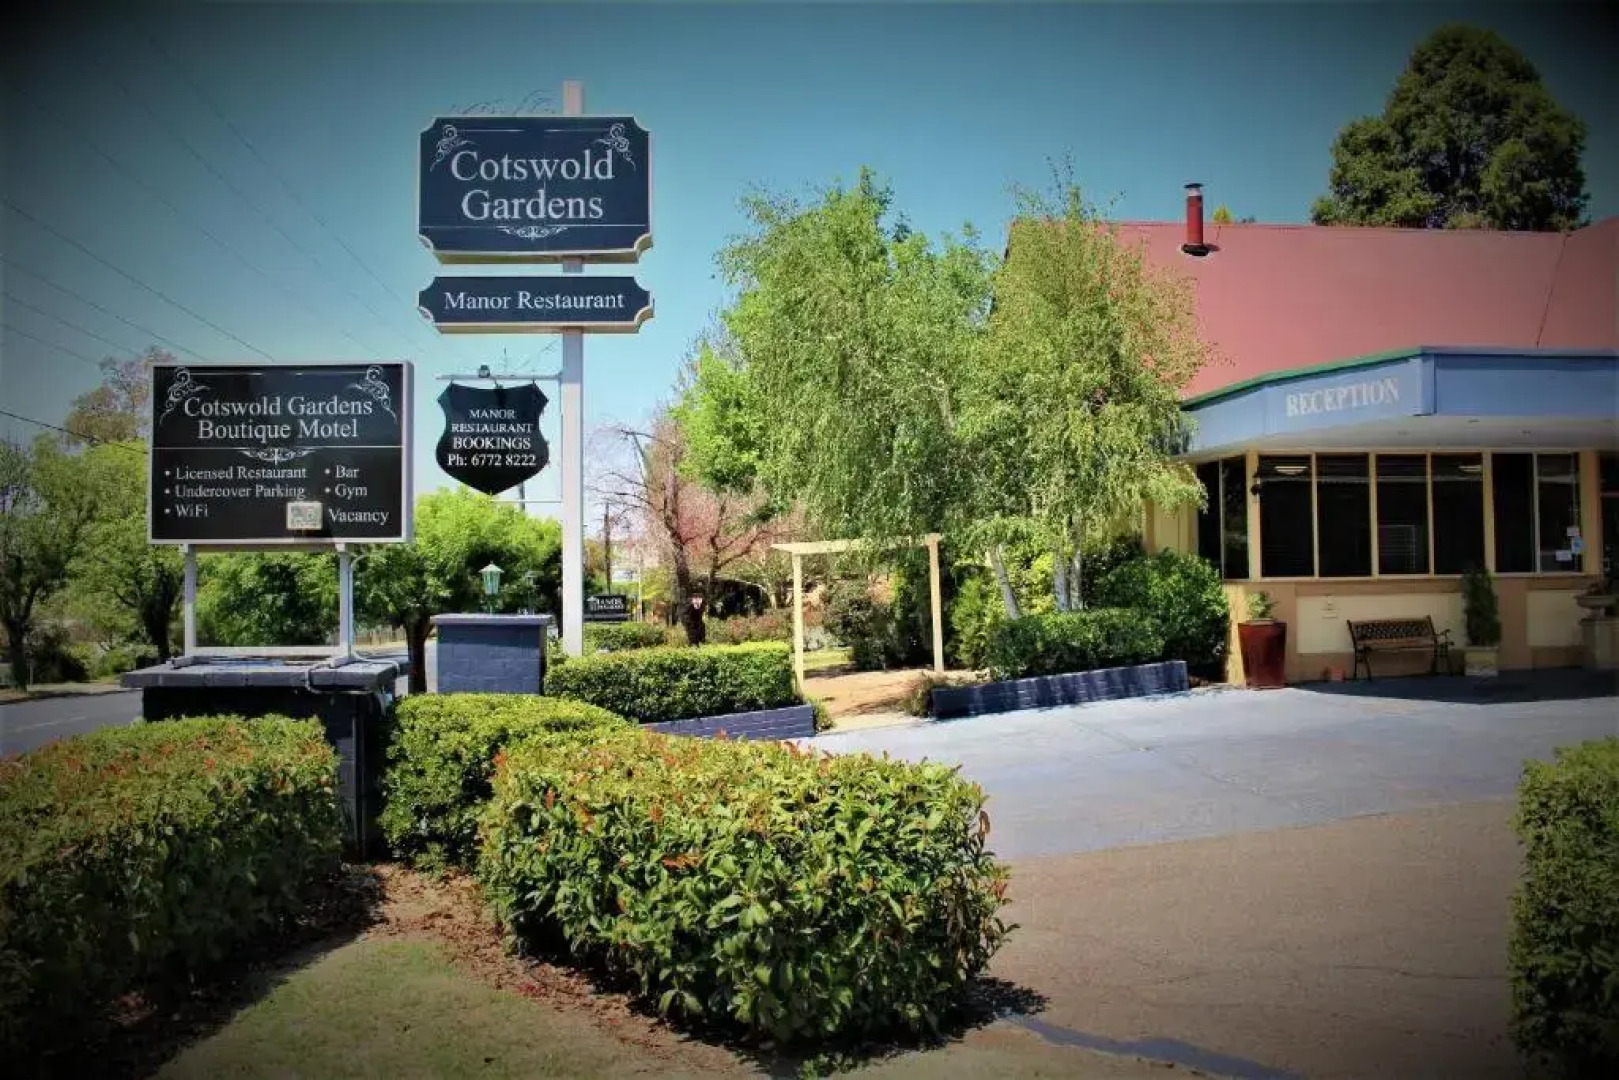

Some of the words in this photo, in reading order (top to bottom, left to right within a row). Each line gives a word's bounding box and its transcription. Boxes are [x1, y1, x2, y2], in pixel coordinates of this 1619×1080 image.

[450, 147, 615, 181] Cotswold
[461, 189, 604, 221] Gardens
[443, 291, 512, 310] Manor
[516, 290, 625, 310] Restaurant
[183, 396, 281, 417] Cotswold
[287, 395, 374, 417] Gardens
[1286, 378, 1400, 417] RECEPTION
[469, 408, 517, 420] MANOR
[197, 419, 292, 443] Boutique
[297, 418, 359, 439] Motel
[451, 423, 534, 433] RESTAURANT
[453, 437, 532, 450] BOOKINGS
[447, 454, 468, 467] Ph:
[471, 453, 502, 467] 6772
[505, 453, 537, 467] 8222
[175, 466, 234, 480] Licensed
[236, 466, 308, 480] Restaurant
[335, 465, 361, 479] Bar
[174, 485, 252, 498] Undercover
[254, 484, 306, 501] Parking
[334, 483, 368, 501] Gym
[175, 503, 209, 518] WiFi
[328, 508, 390, 526] Vacancy
